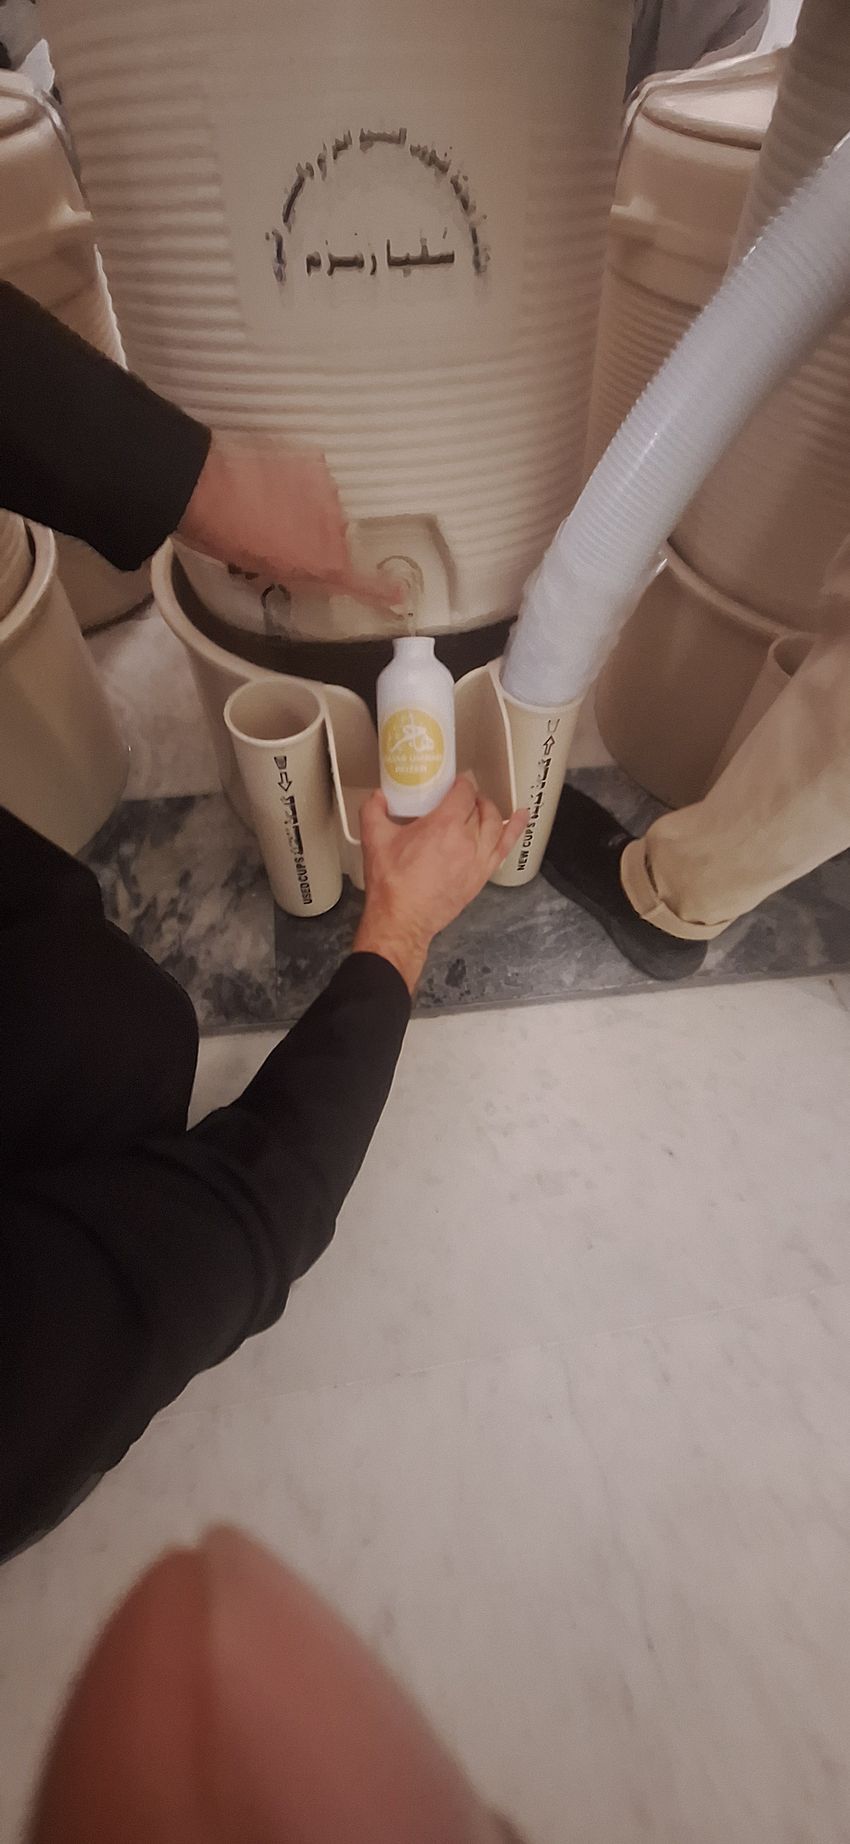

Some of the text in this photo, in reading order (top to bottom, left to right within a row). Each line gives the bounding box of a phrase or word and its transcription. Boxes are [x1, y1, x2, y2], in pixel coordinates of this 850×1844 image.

[516, 822, 536, 871] NEW CUPS
[294, 857, 313, 905] USED CUPS
